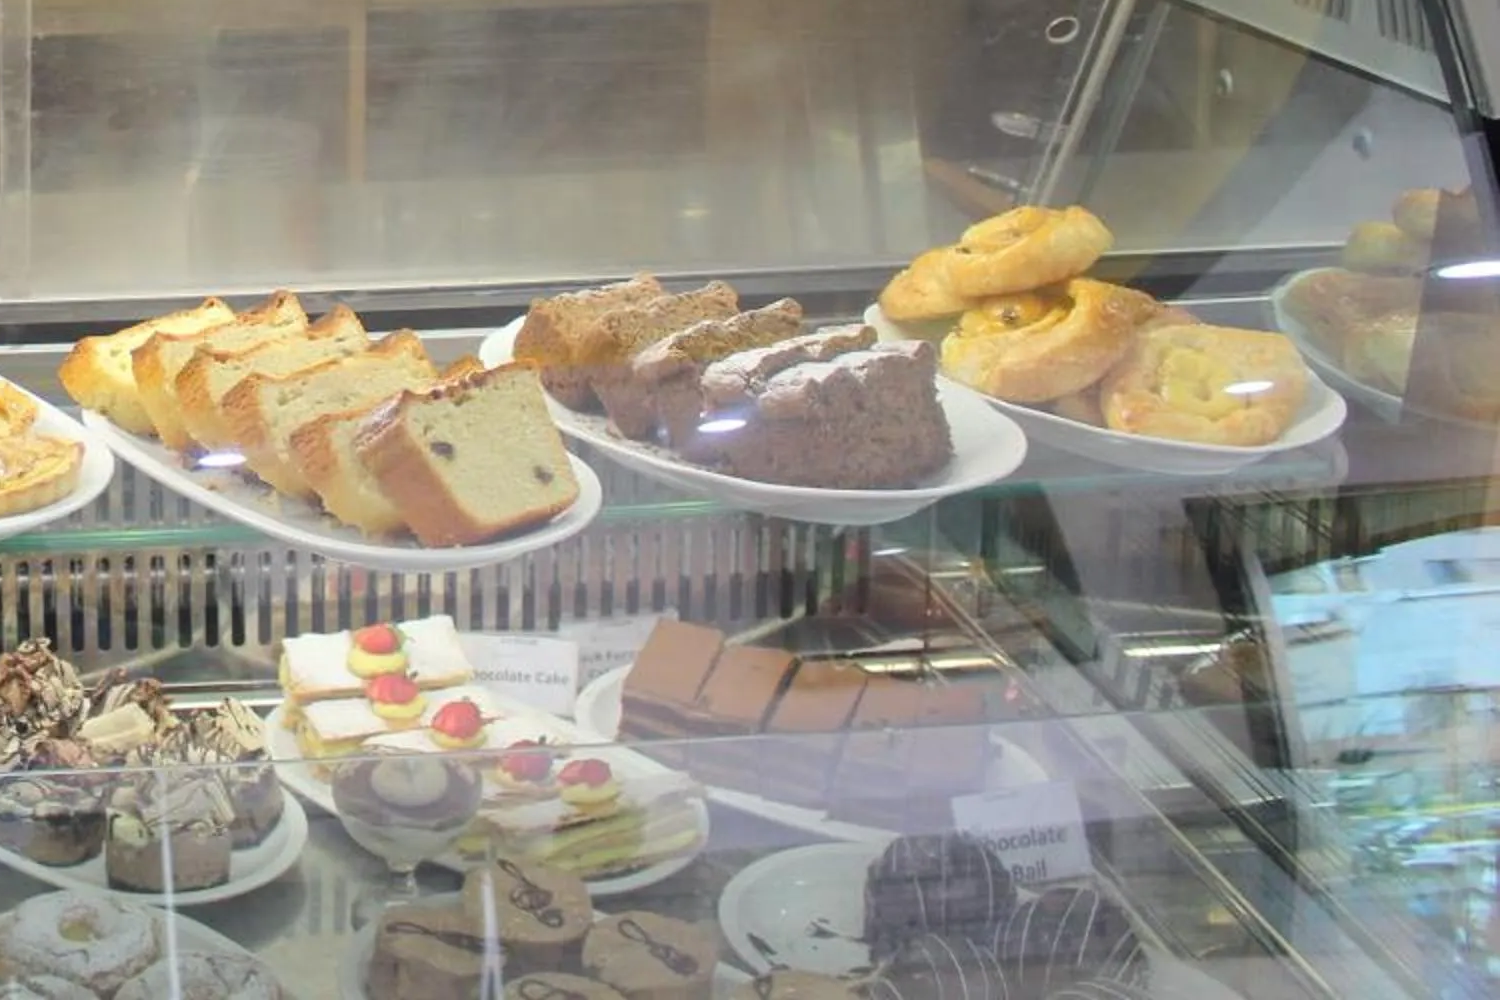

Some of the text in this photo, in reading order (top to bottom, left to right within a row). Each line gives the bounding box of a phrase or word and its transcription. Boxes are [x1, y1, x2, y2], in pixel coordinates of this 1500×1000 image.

[470, 667, 569, 685] ocolate Cake
[1011, 858, 1047, 880] Ball
